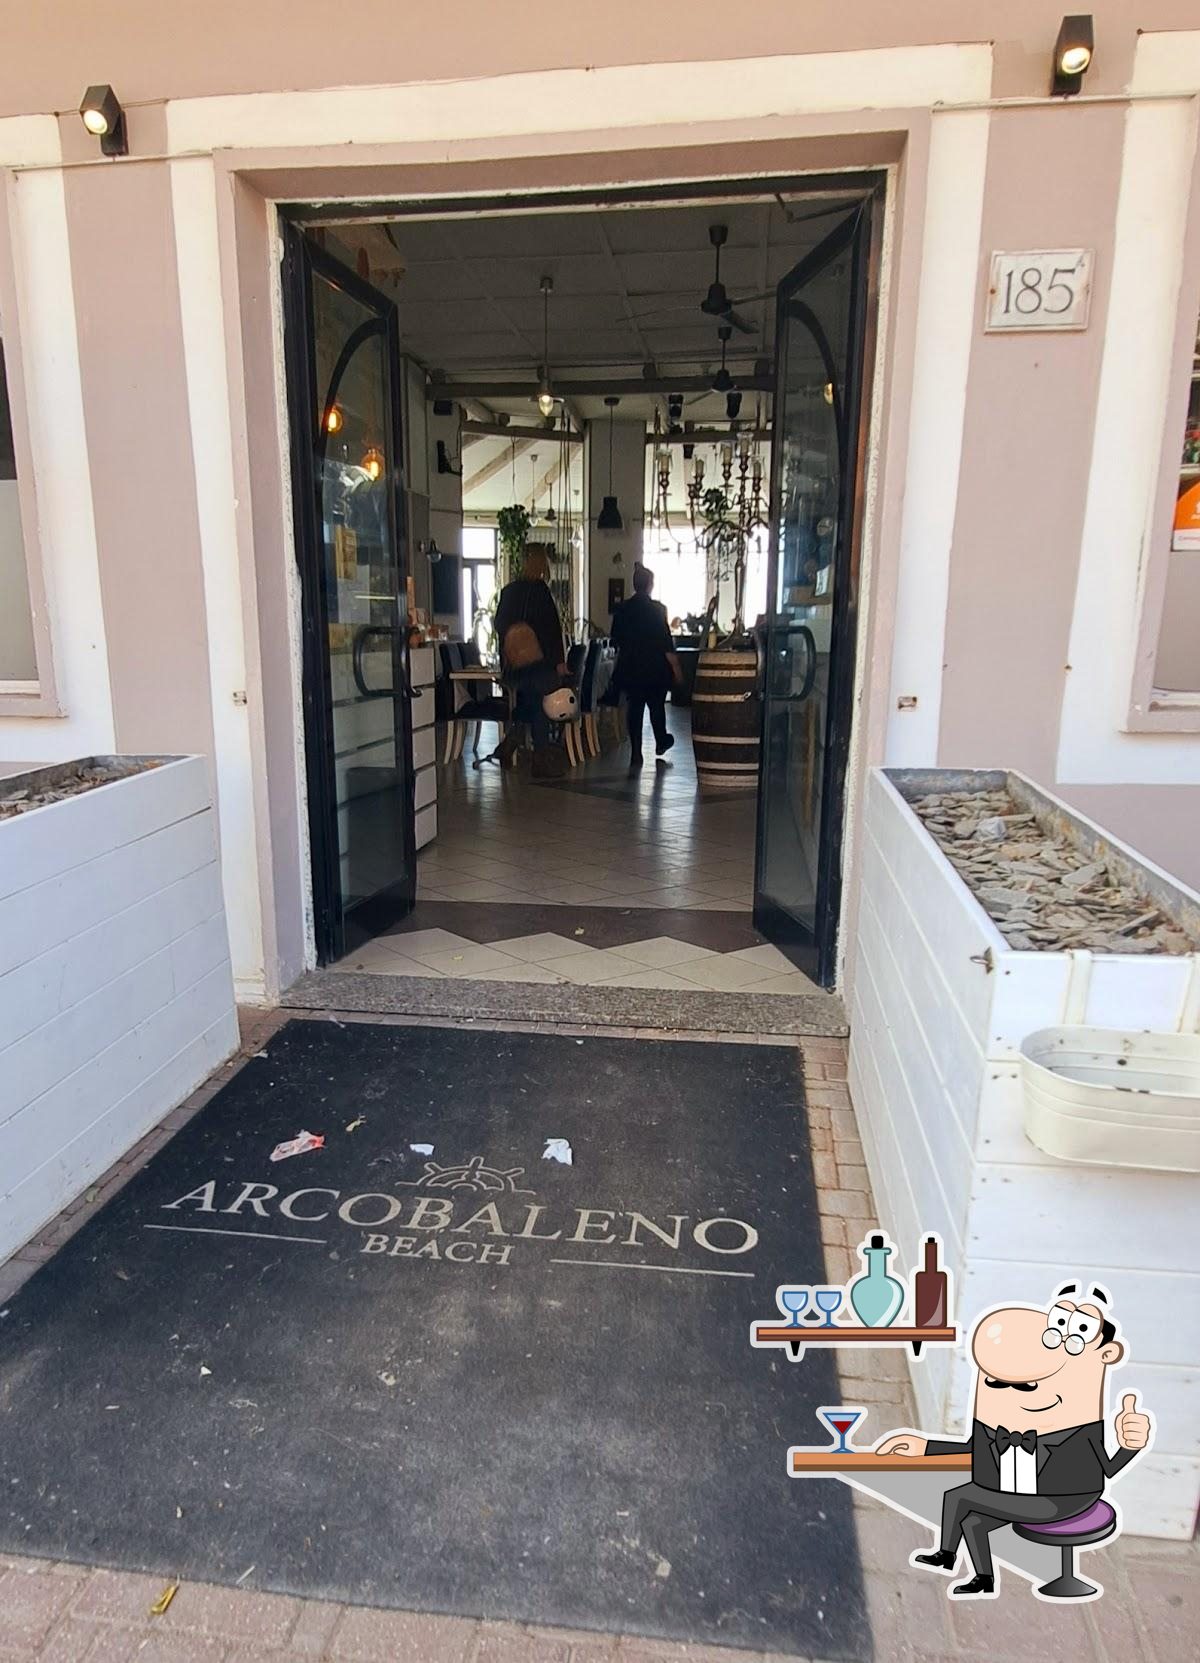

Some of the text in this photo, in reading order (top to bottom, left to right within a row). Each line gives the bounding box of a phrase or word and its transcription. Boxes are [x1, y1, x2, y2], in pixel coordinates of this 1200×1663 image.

[1003, 267, 1075, 314] 185
[161, 1180, 758, 1254] ARCOBALENO
[360, 1233, 515, 1266] BEACH
